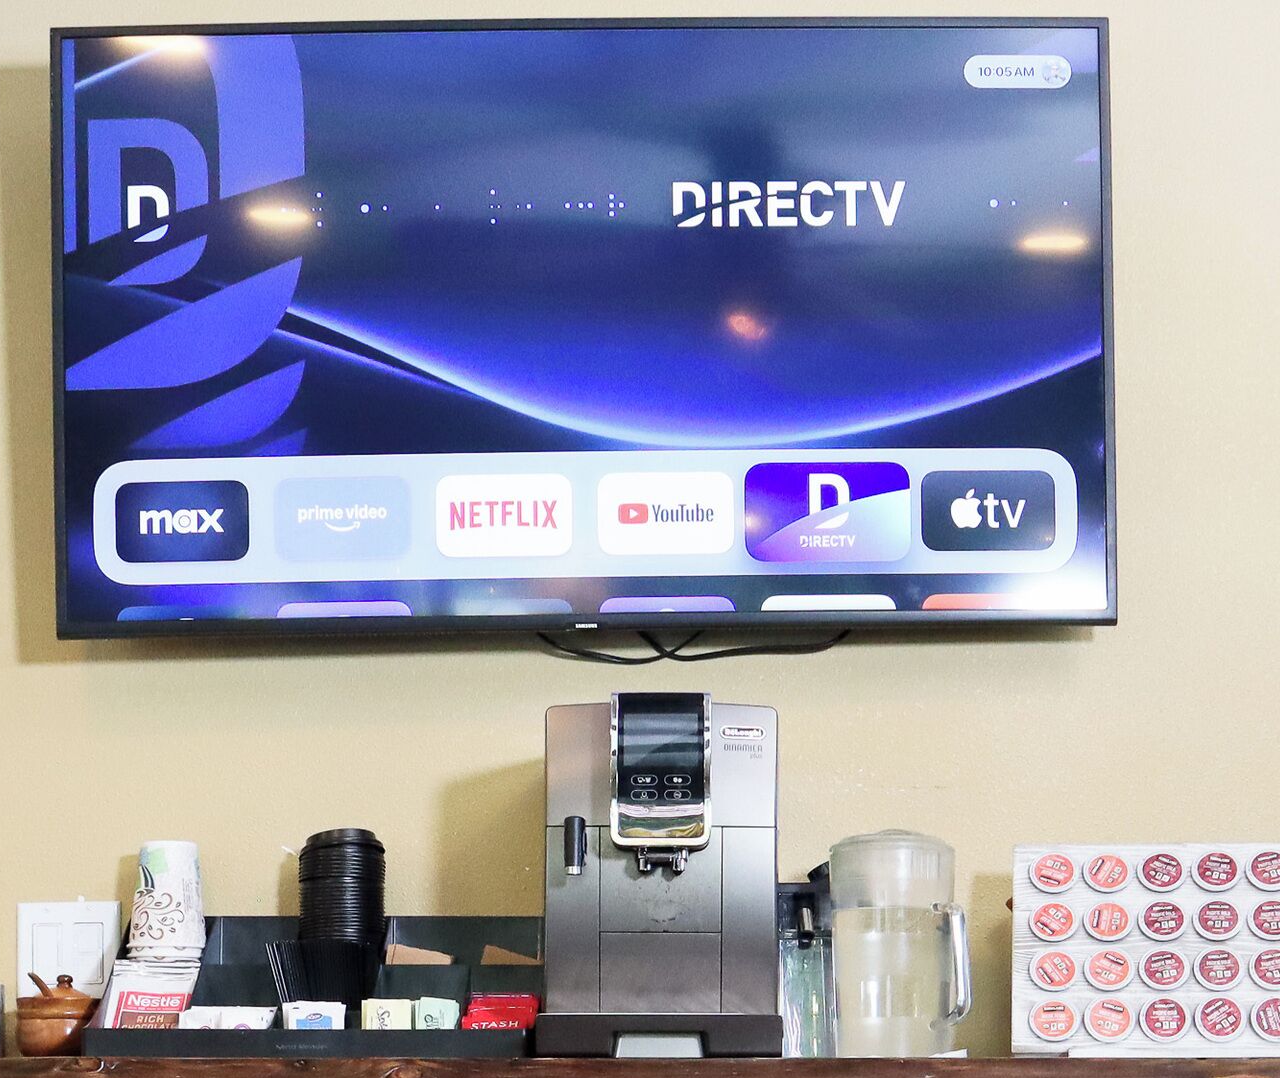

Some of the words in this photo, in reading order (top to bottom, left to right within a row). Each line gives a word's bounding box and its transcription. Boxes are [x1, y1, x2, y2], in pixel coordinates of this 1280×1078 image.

[977, 66, 1013, 78] 10:05
[1014, 66, 1035, 78] AM
[672, 180, 905, 227] DIRECTV
[297, 504, 344, 522] prime
[346, 504, 387, 520] video
[449, 500, 558, 530] NETFLIX
[652, 504, 714, 524] YouTube
[987, 492, 1026, 528] tv
[139, 507, 225, 535] max
[800, 534, 855, 548] DIRECTV
[136, 1014, 165, 1023] RICH
[470, 1020, 519, 1029] STASH
